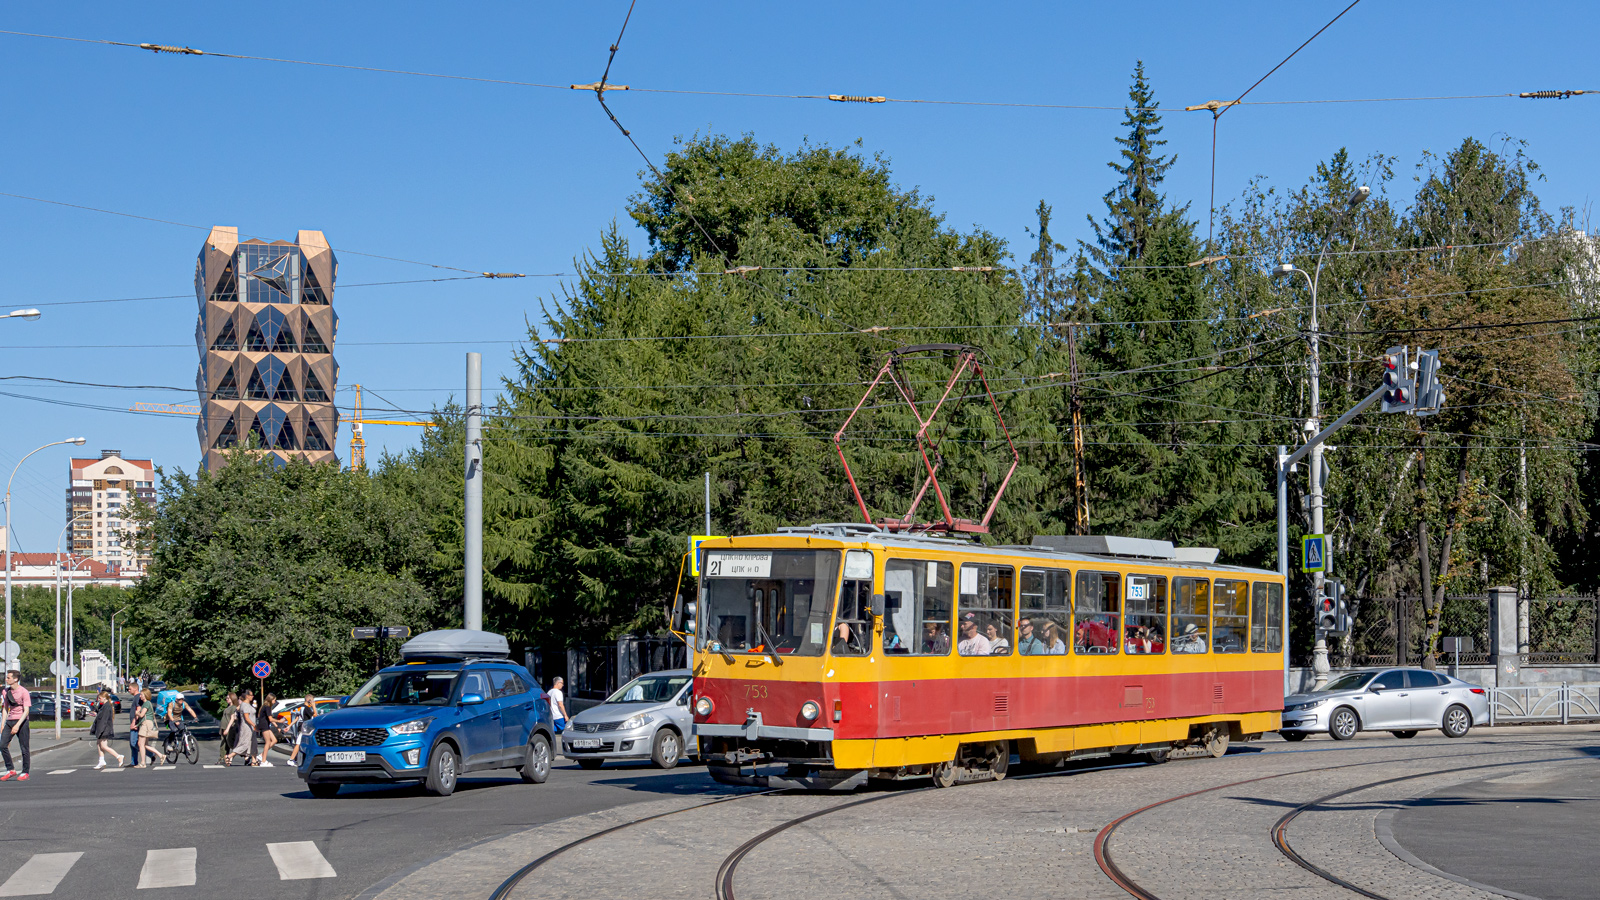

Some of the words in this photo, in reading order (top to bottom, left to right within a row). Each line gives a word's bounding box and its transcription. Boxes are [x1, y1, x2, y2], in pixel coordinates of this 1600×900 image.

[710, 561, 722, 575] 21
[731, 565, 745, 573] ЦПК
[1131, 586, 1143, 597] 753
[69, 678, 77, 688] P
[743, 684, 768, 699] 753
